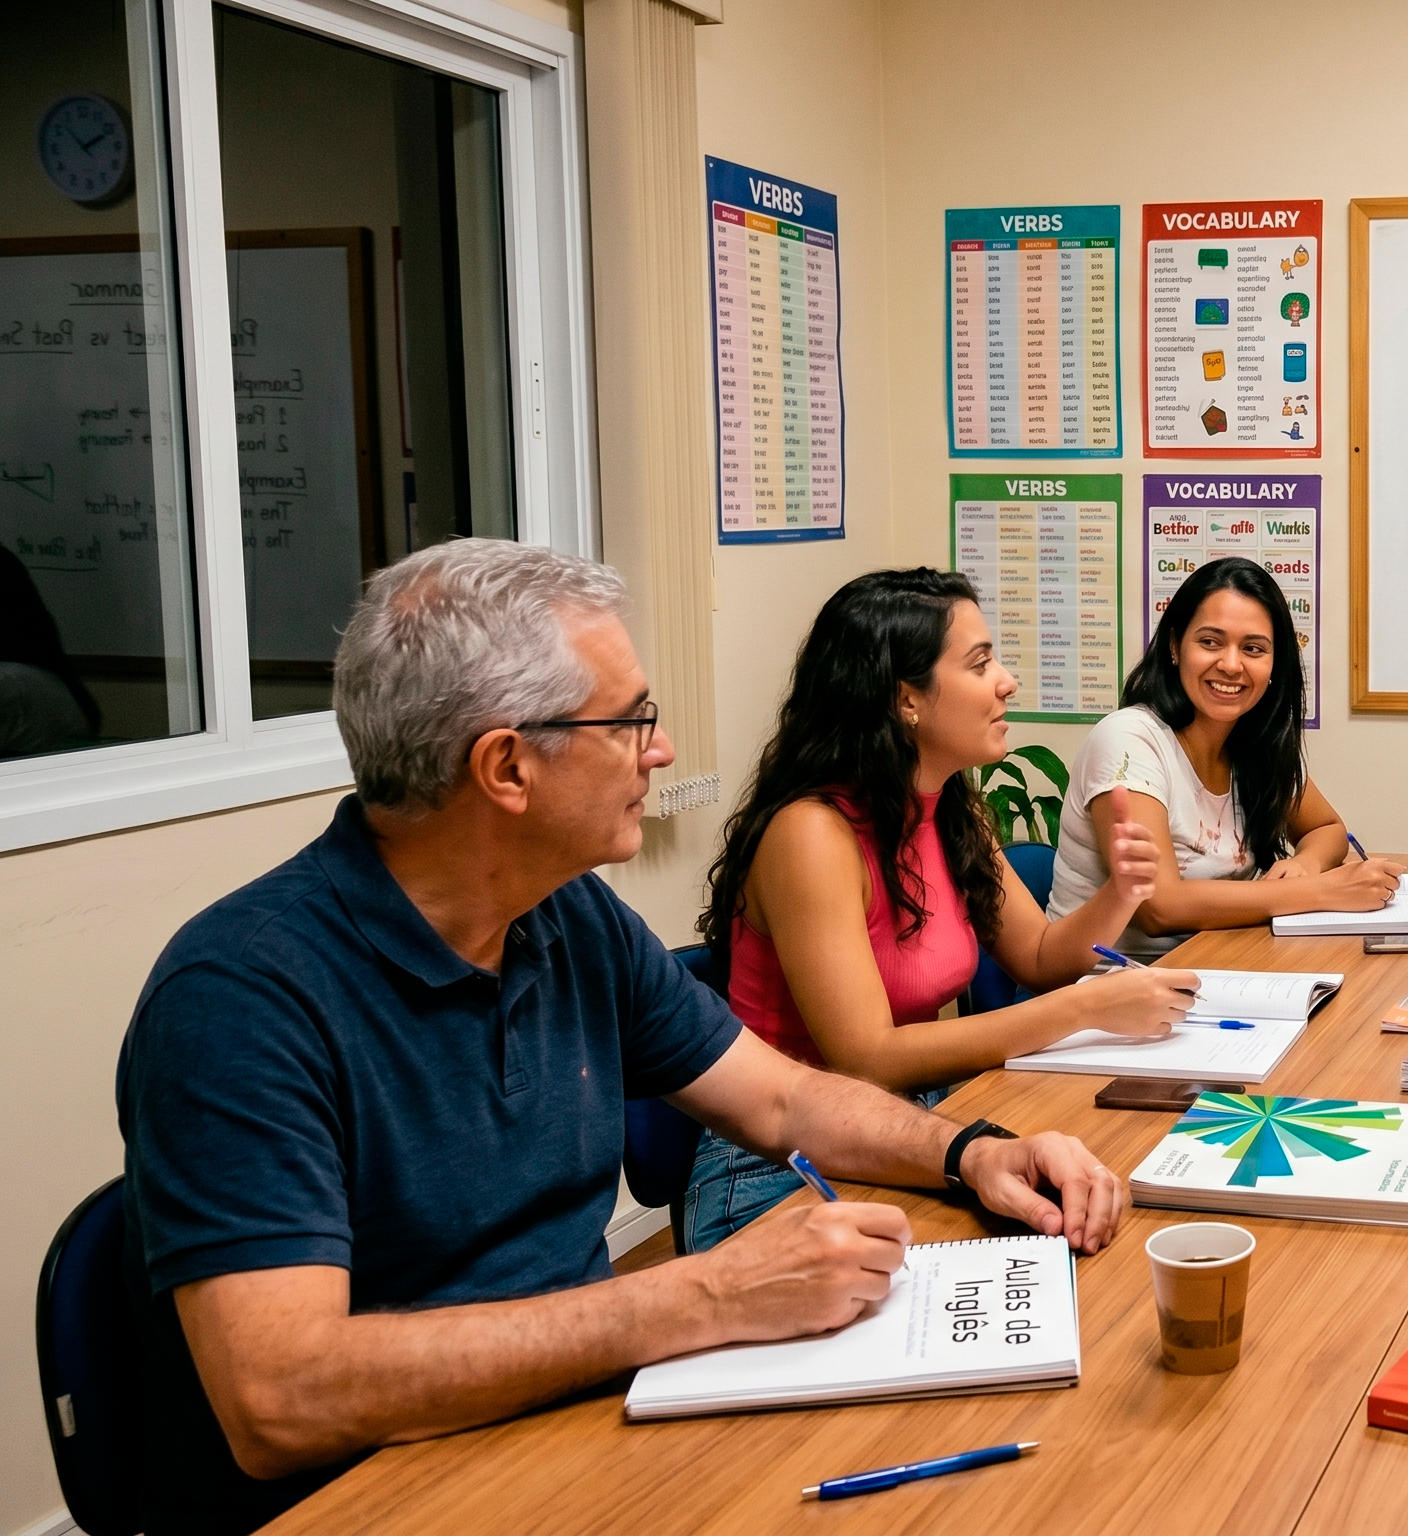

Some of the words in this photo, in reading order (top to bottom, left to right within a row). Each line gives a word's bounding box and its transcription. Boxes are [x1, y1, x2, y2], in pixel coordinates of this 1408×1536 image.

[749, 177, 804, 217] VERBS
[1001, 214, 1063, 232] VERBS
[1162, 210, 1300, 231] VOCABULARY
[1005, 480, 1067, 497] VERBS
[1166, 482, 1298, 499] VOCABULARY
[1005, 1258, 1040, 1311] Aulas
[945, 1279, 993, 1343] Inglês
[1004, 1319, 1041, 1345] de
